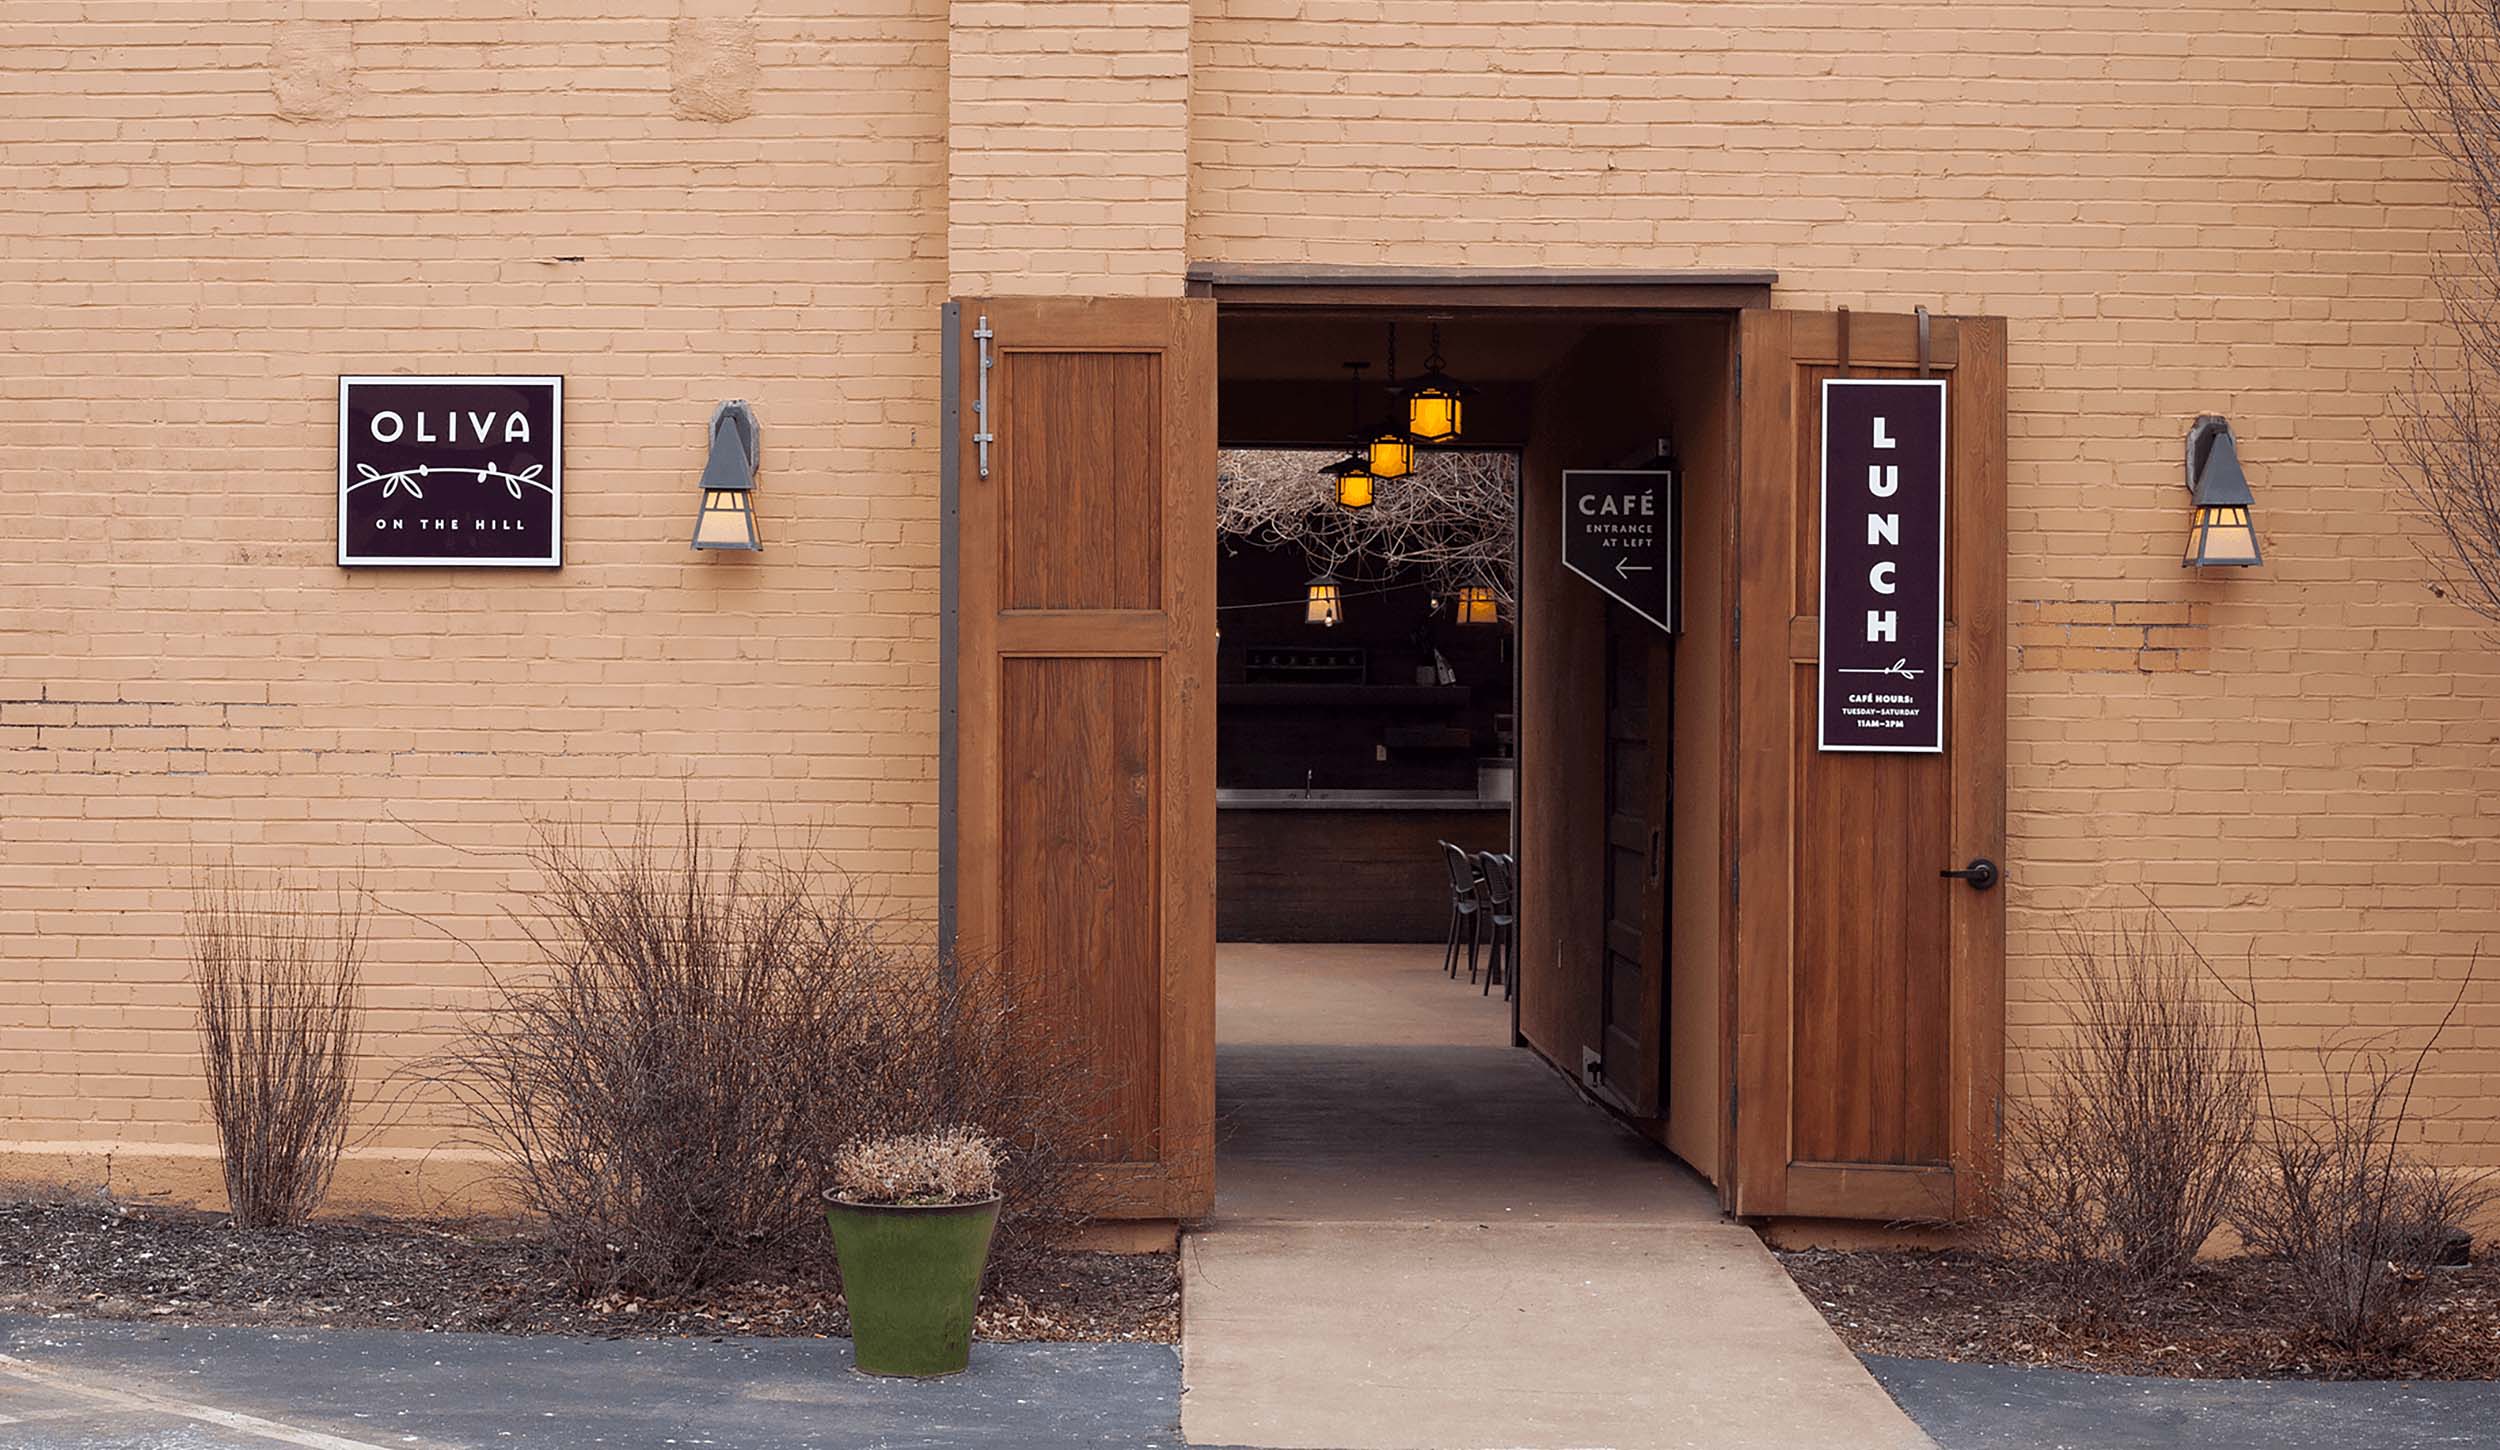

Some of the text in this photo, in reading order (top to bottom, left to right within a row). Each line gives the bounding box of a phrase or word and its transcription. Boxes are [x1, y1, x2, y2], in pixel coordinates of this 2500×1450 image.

[370, 410, 530, 443] OLIVA
[1578, 489, 1654, 515] CAFÉ
[375, 518, 525, 530] ON THE HILL
[1586, 524, 1652, 533] ENTRANCE
[1867, 416, 1899, 642] LUNCH
[1602, 538, 1652, 547] AT LEFT
[1848, 693, 1913, 703] CAFÉ HOURS:
